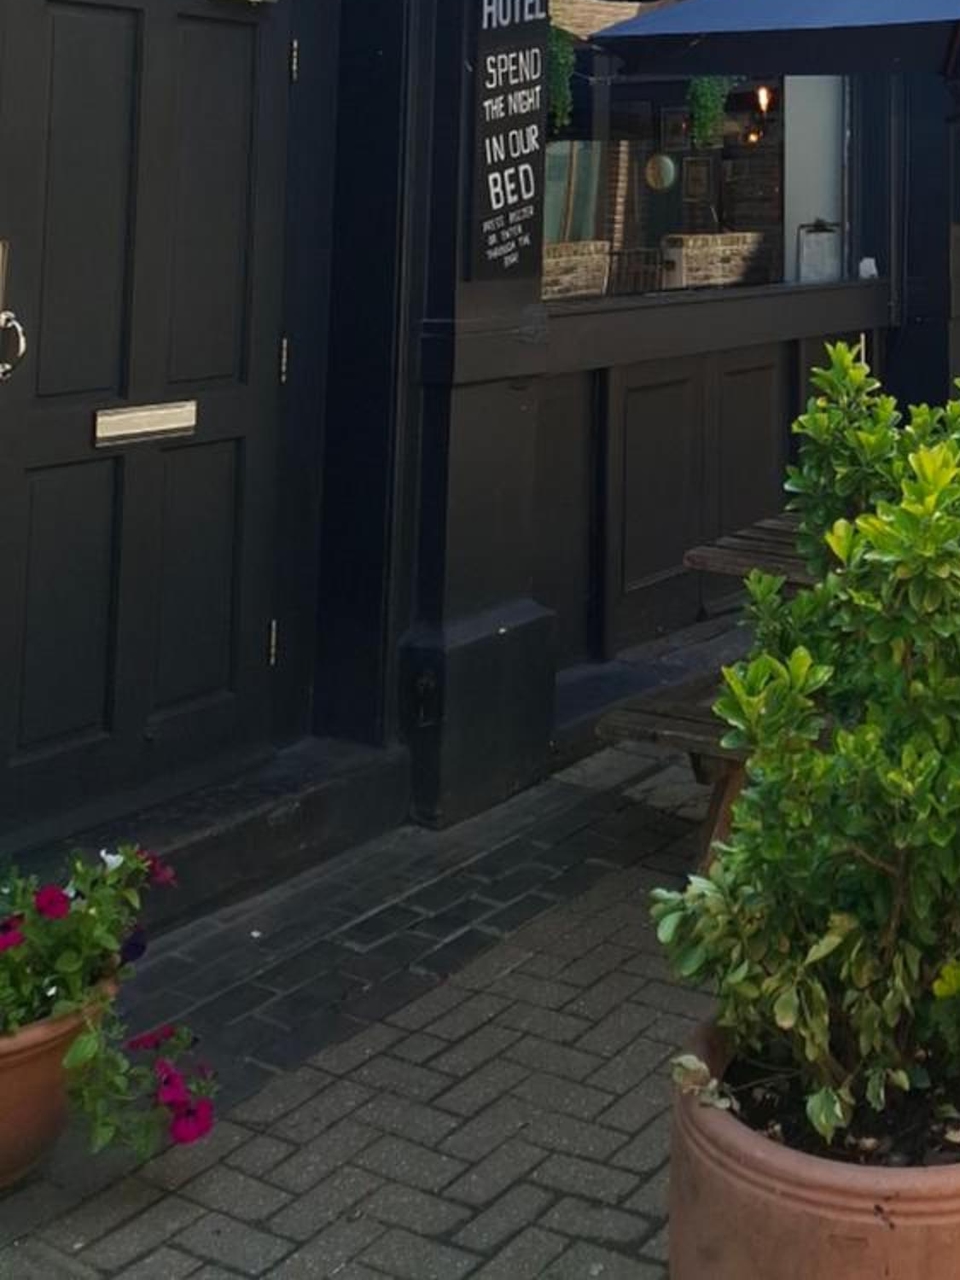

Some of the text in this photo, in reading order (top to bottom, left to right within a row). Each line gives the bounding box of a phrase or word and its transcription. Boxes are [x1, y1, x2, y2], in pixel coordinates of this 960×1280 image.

[485, 48, 541, 89] SPEND
[483, 85, 542, 122] THE NIGHT
[485, 124, 540, 164] IN OUR
[488, 163, 535, 210] BED
